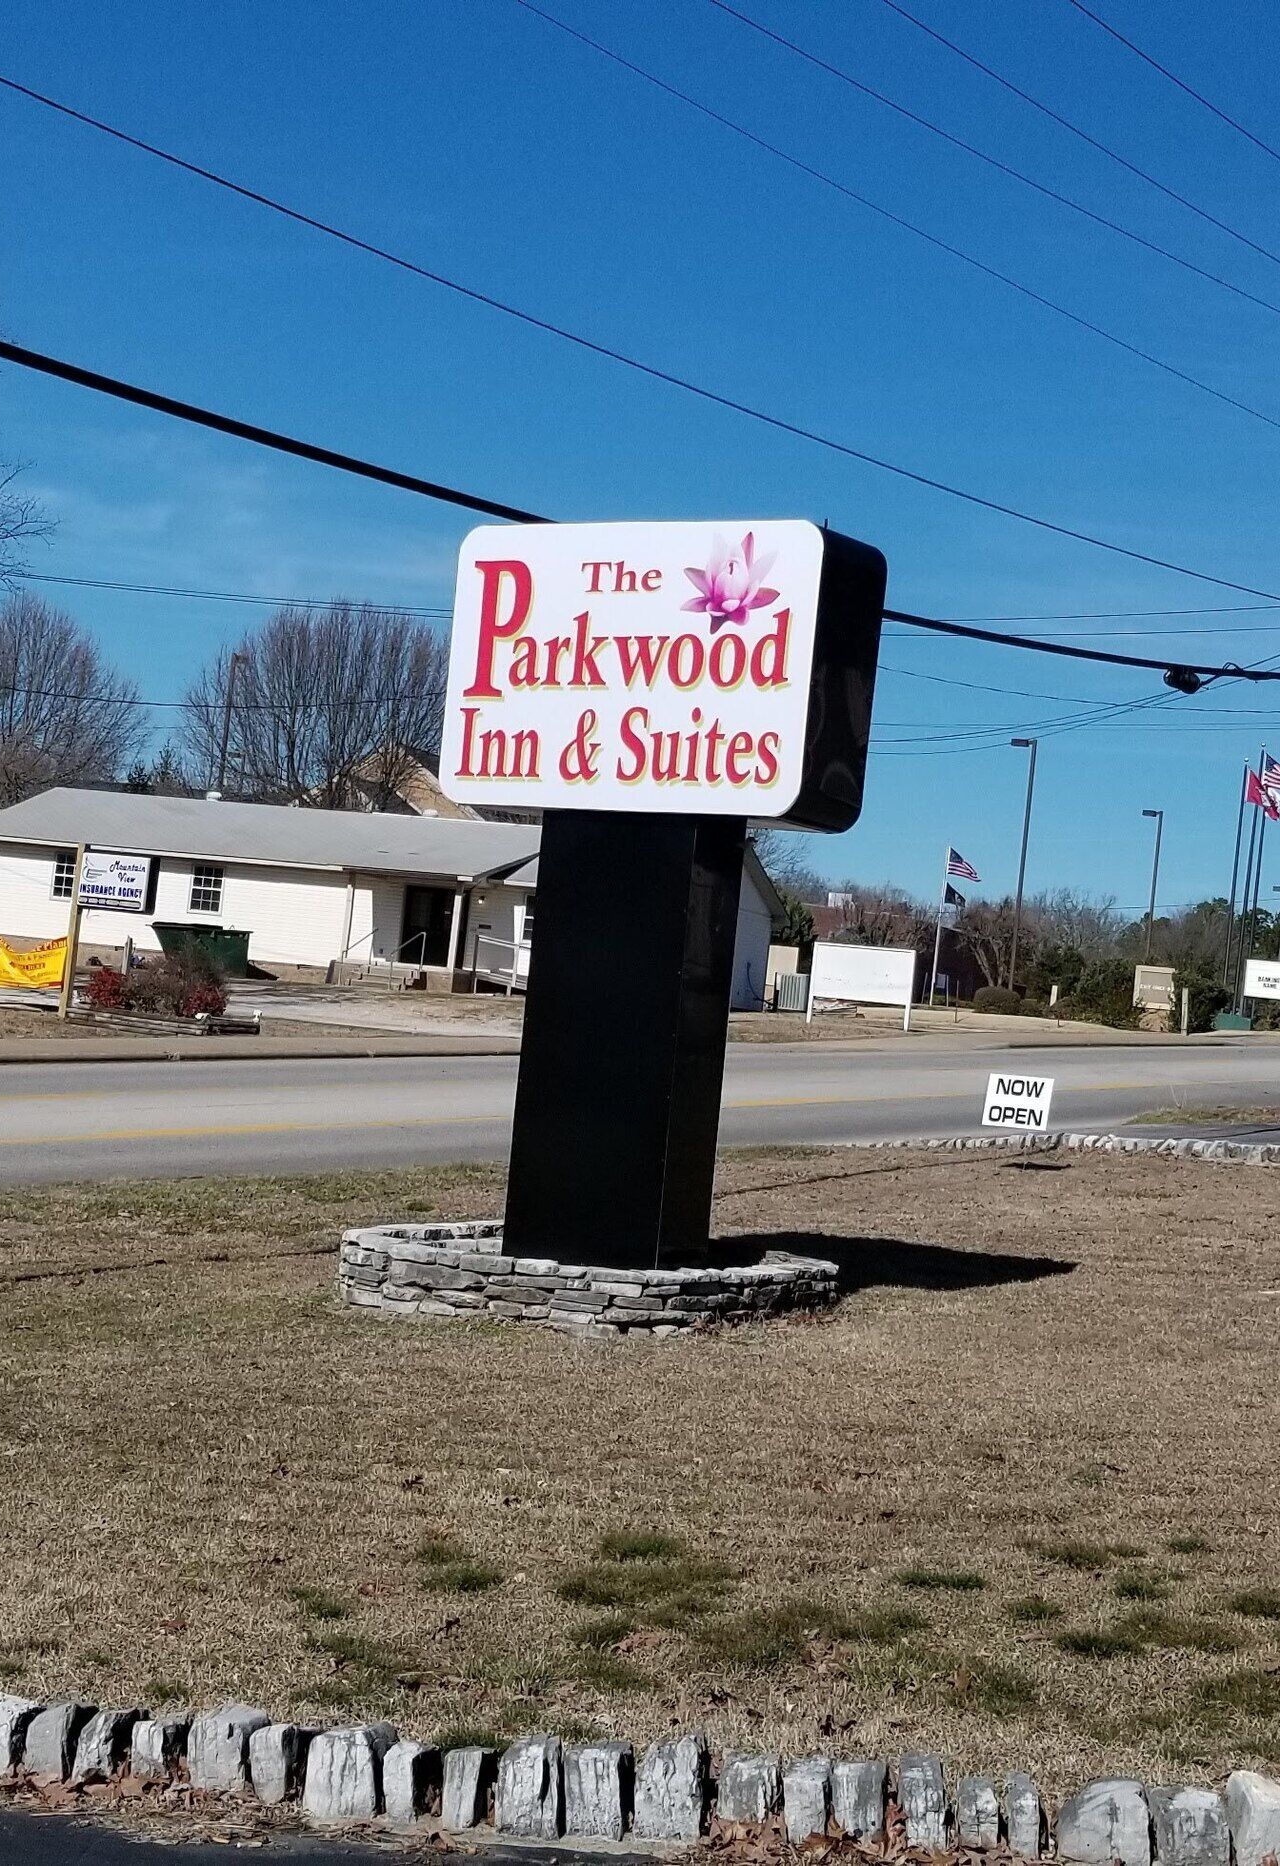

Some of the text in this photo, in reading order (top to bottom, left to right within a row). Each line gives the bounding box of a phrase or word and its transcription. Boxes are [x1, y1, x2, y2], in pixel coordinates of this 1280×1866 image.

[581, 560, 662, 592] The
[463, 560, 792, 699] Parkwood
[455, 706, 781, 785] Inn & Suites
[109, 860, 146, 873] Mountain
[117, 872, 136, 883] View
[80, 883, 143, 898] INSURANCE AGENCY
[996, 1078, 1044, 1098] NOW
[988, 1105, 1043, 1126] OPEN
